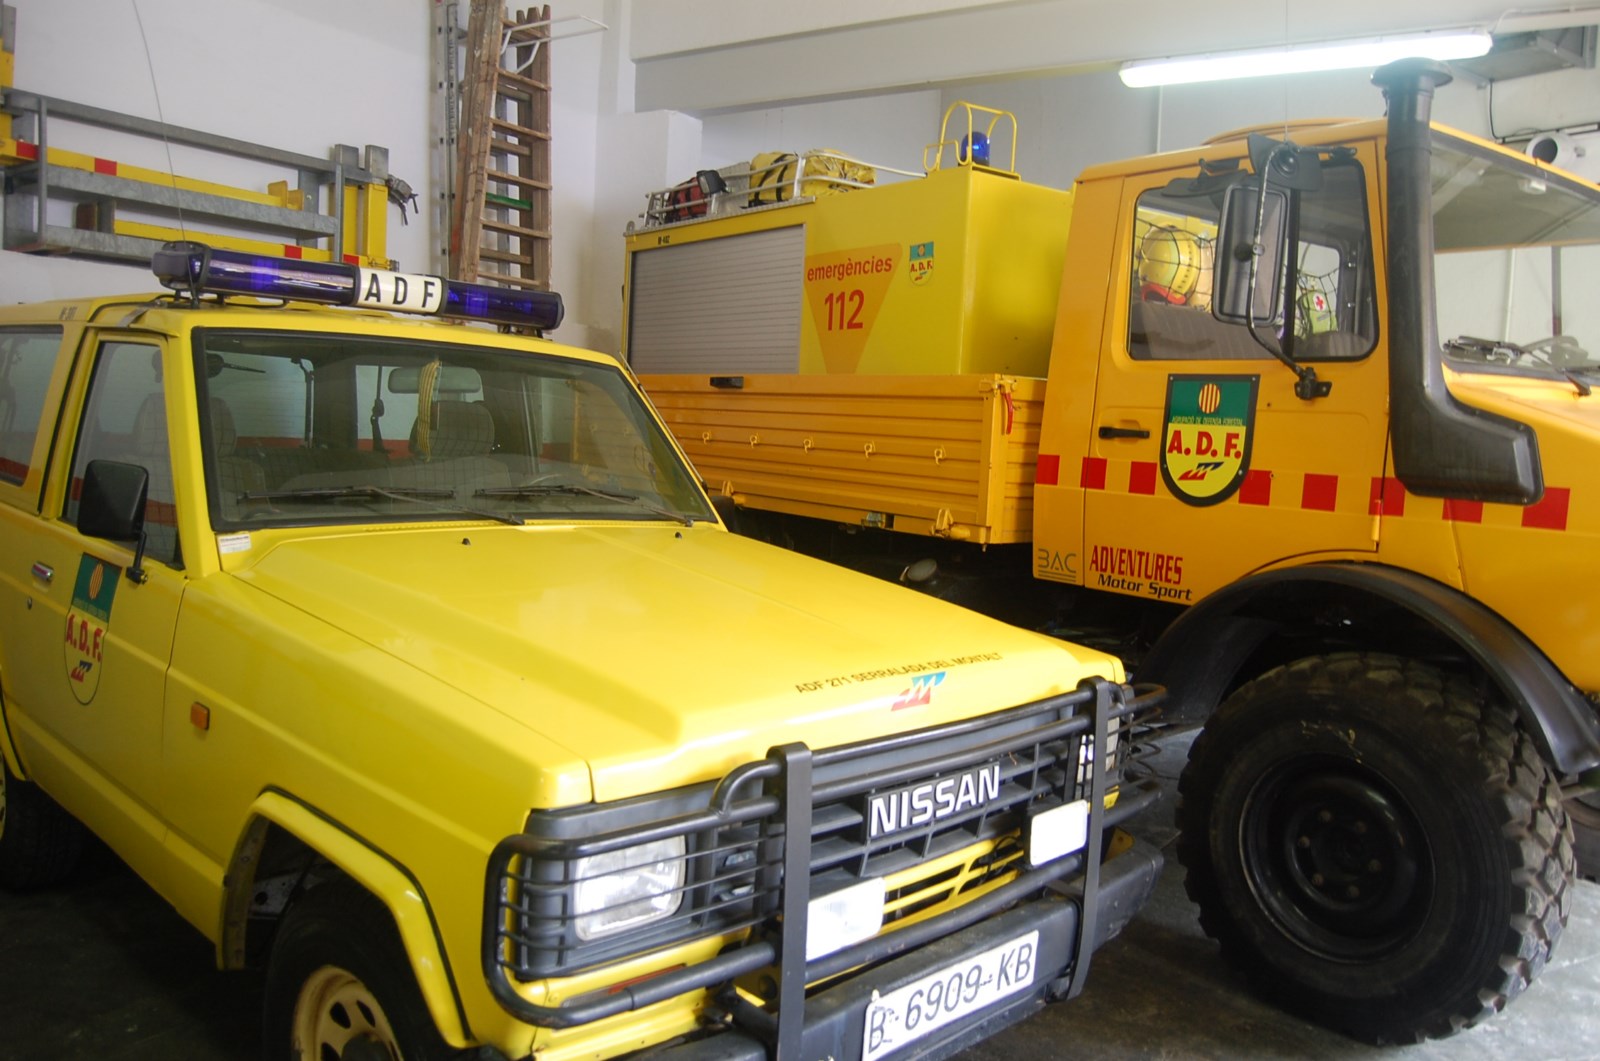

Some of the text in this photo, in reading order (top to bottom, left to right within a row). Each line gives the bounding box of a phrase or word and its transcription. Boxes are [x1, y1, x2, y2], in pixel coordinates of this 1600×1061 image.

[807, 256, 893, 282] emergències
[824, 288, 865, 332] 112
[1038, 548, 1077, 574] BAC
[1089, 545, 1184, 585] ADVENTURES
[1098, 573, 1193, 601] Motor Sport
[795, 681, 824, 694] ADF
[825, 677, 852, 687] 271
[850, 663, 927, 682] SERRALADA
[927, 659, 955, 669] DEL
[870, 765, 1000, 837] NISSAN
